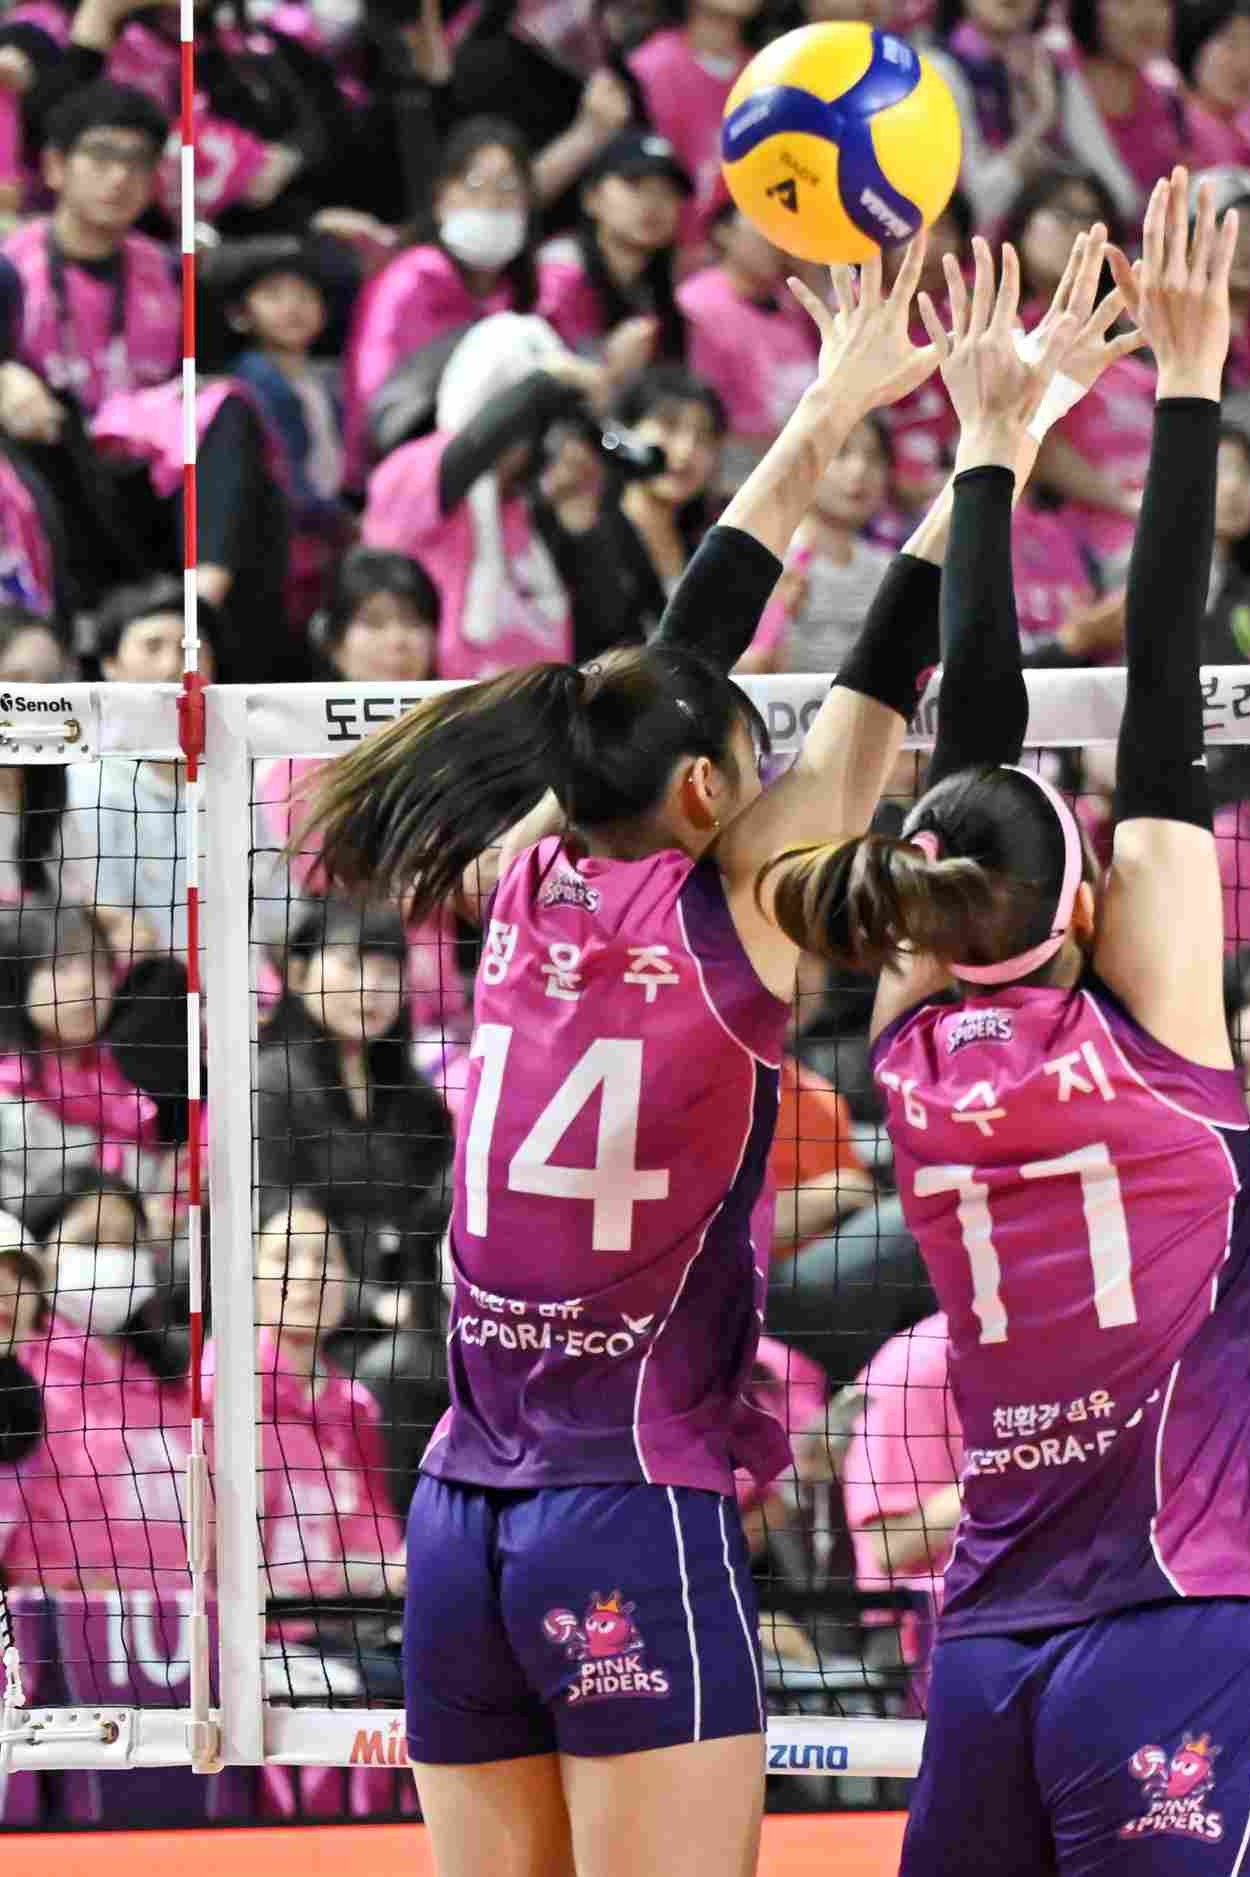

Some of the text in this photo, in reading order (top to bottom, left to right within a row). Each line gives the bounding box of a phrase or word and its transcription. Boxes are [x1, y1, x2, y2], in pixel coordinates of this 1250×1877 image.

[15, 697, 73, 713] Senoh
[465, 1023, 670, 1251] 14
[581, 1655, 641, 1678] PINK
